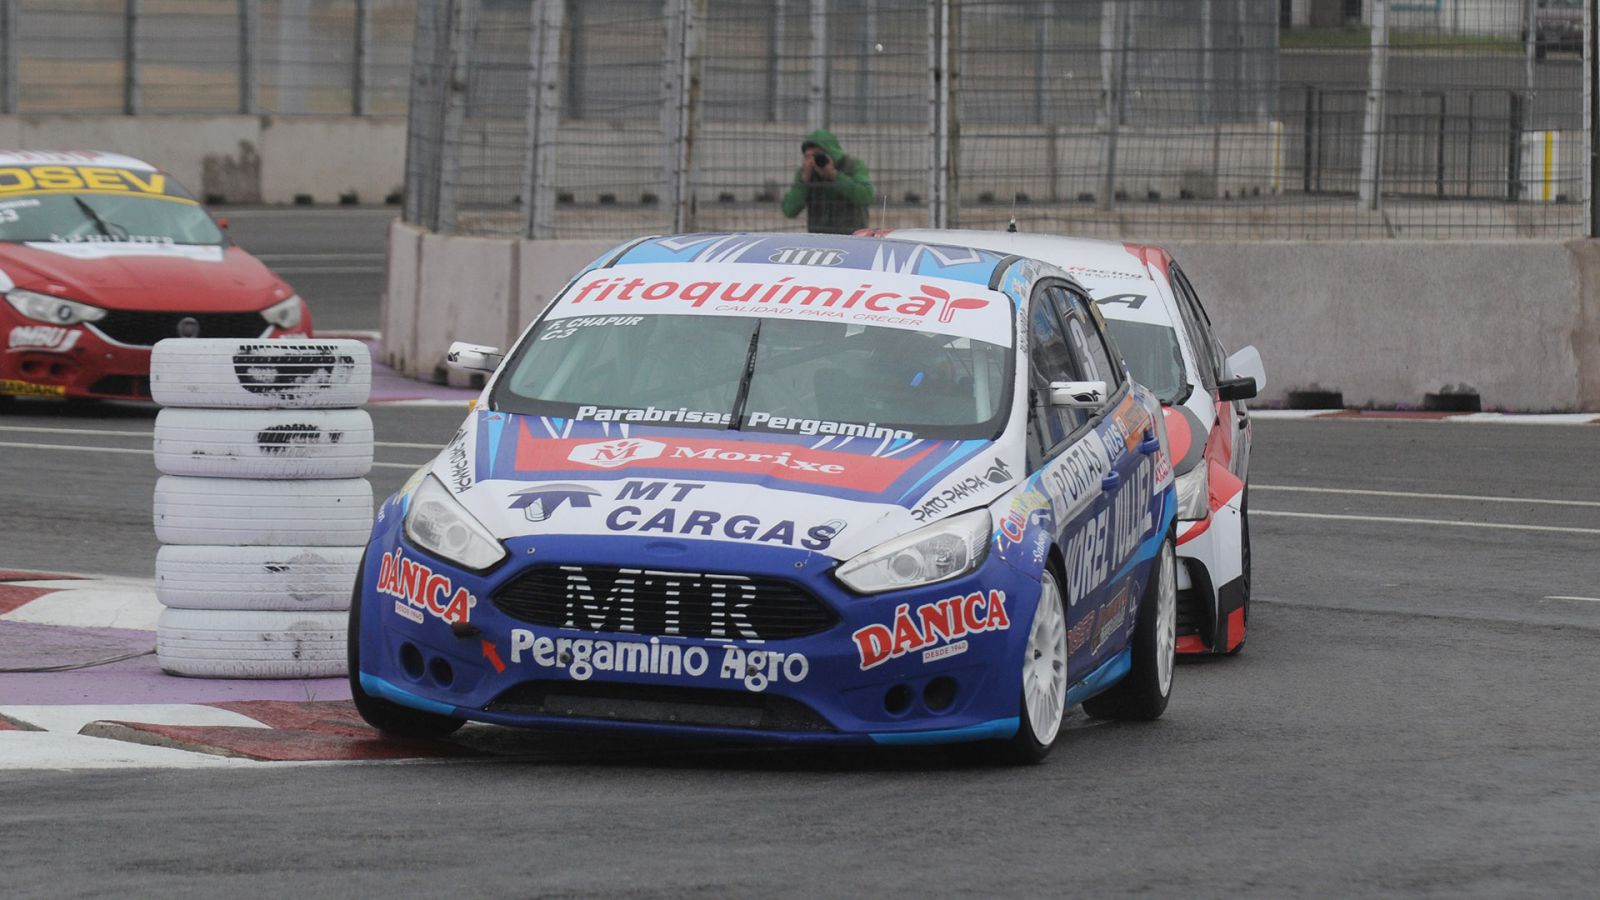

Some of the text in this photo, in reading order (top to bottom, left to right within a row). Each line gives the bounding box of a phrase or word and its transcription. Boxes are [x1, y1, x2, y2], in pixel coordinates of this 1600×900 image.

[571, 276, 936, 318] fitoquímica
[714, 303, 923, 327] CALIDAD PARA CRECER
[540, 327, 579, 341] C3
[566, 315, 645, 329] CHAPUR
[575, 405, 734, 426] Parabrisas
[669, 445, 846, 475] Morixe
[1052, 438, 1103, 510] PORTAS
[614, 480, 706, 502] MT
[910, 473, 990, 523] PATO PAMPA
[605, 505, 837, 551] CARGAS
[376, 546, 471, 625] DÁNICA
[559, 565, 766, 644] MTR
[852, 589, 1010, 670] DÁNICA
[510, 628, 810, 693] Pergamino Agro
[924, 642, 967, 661] DESDE 1940
